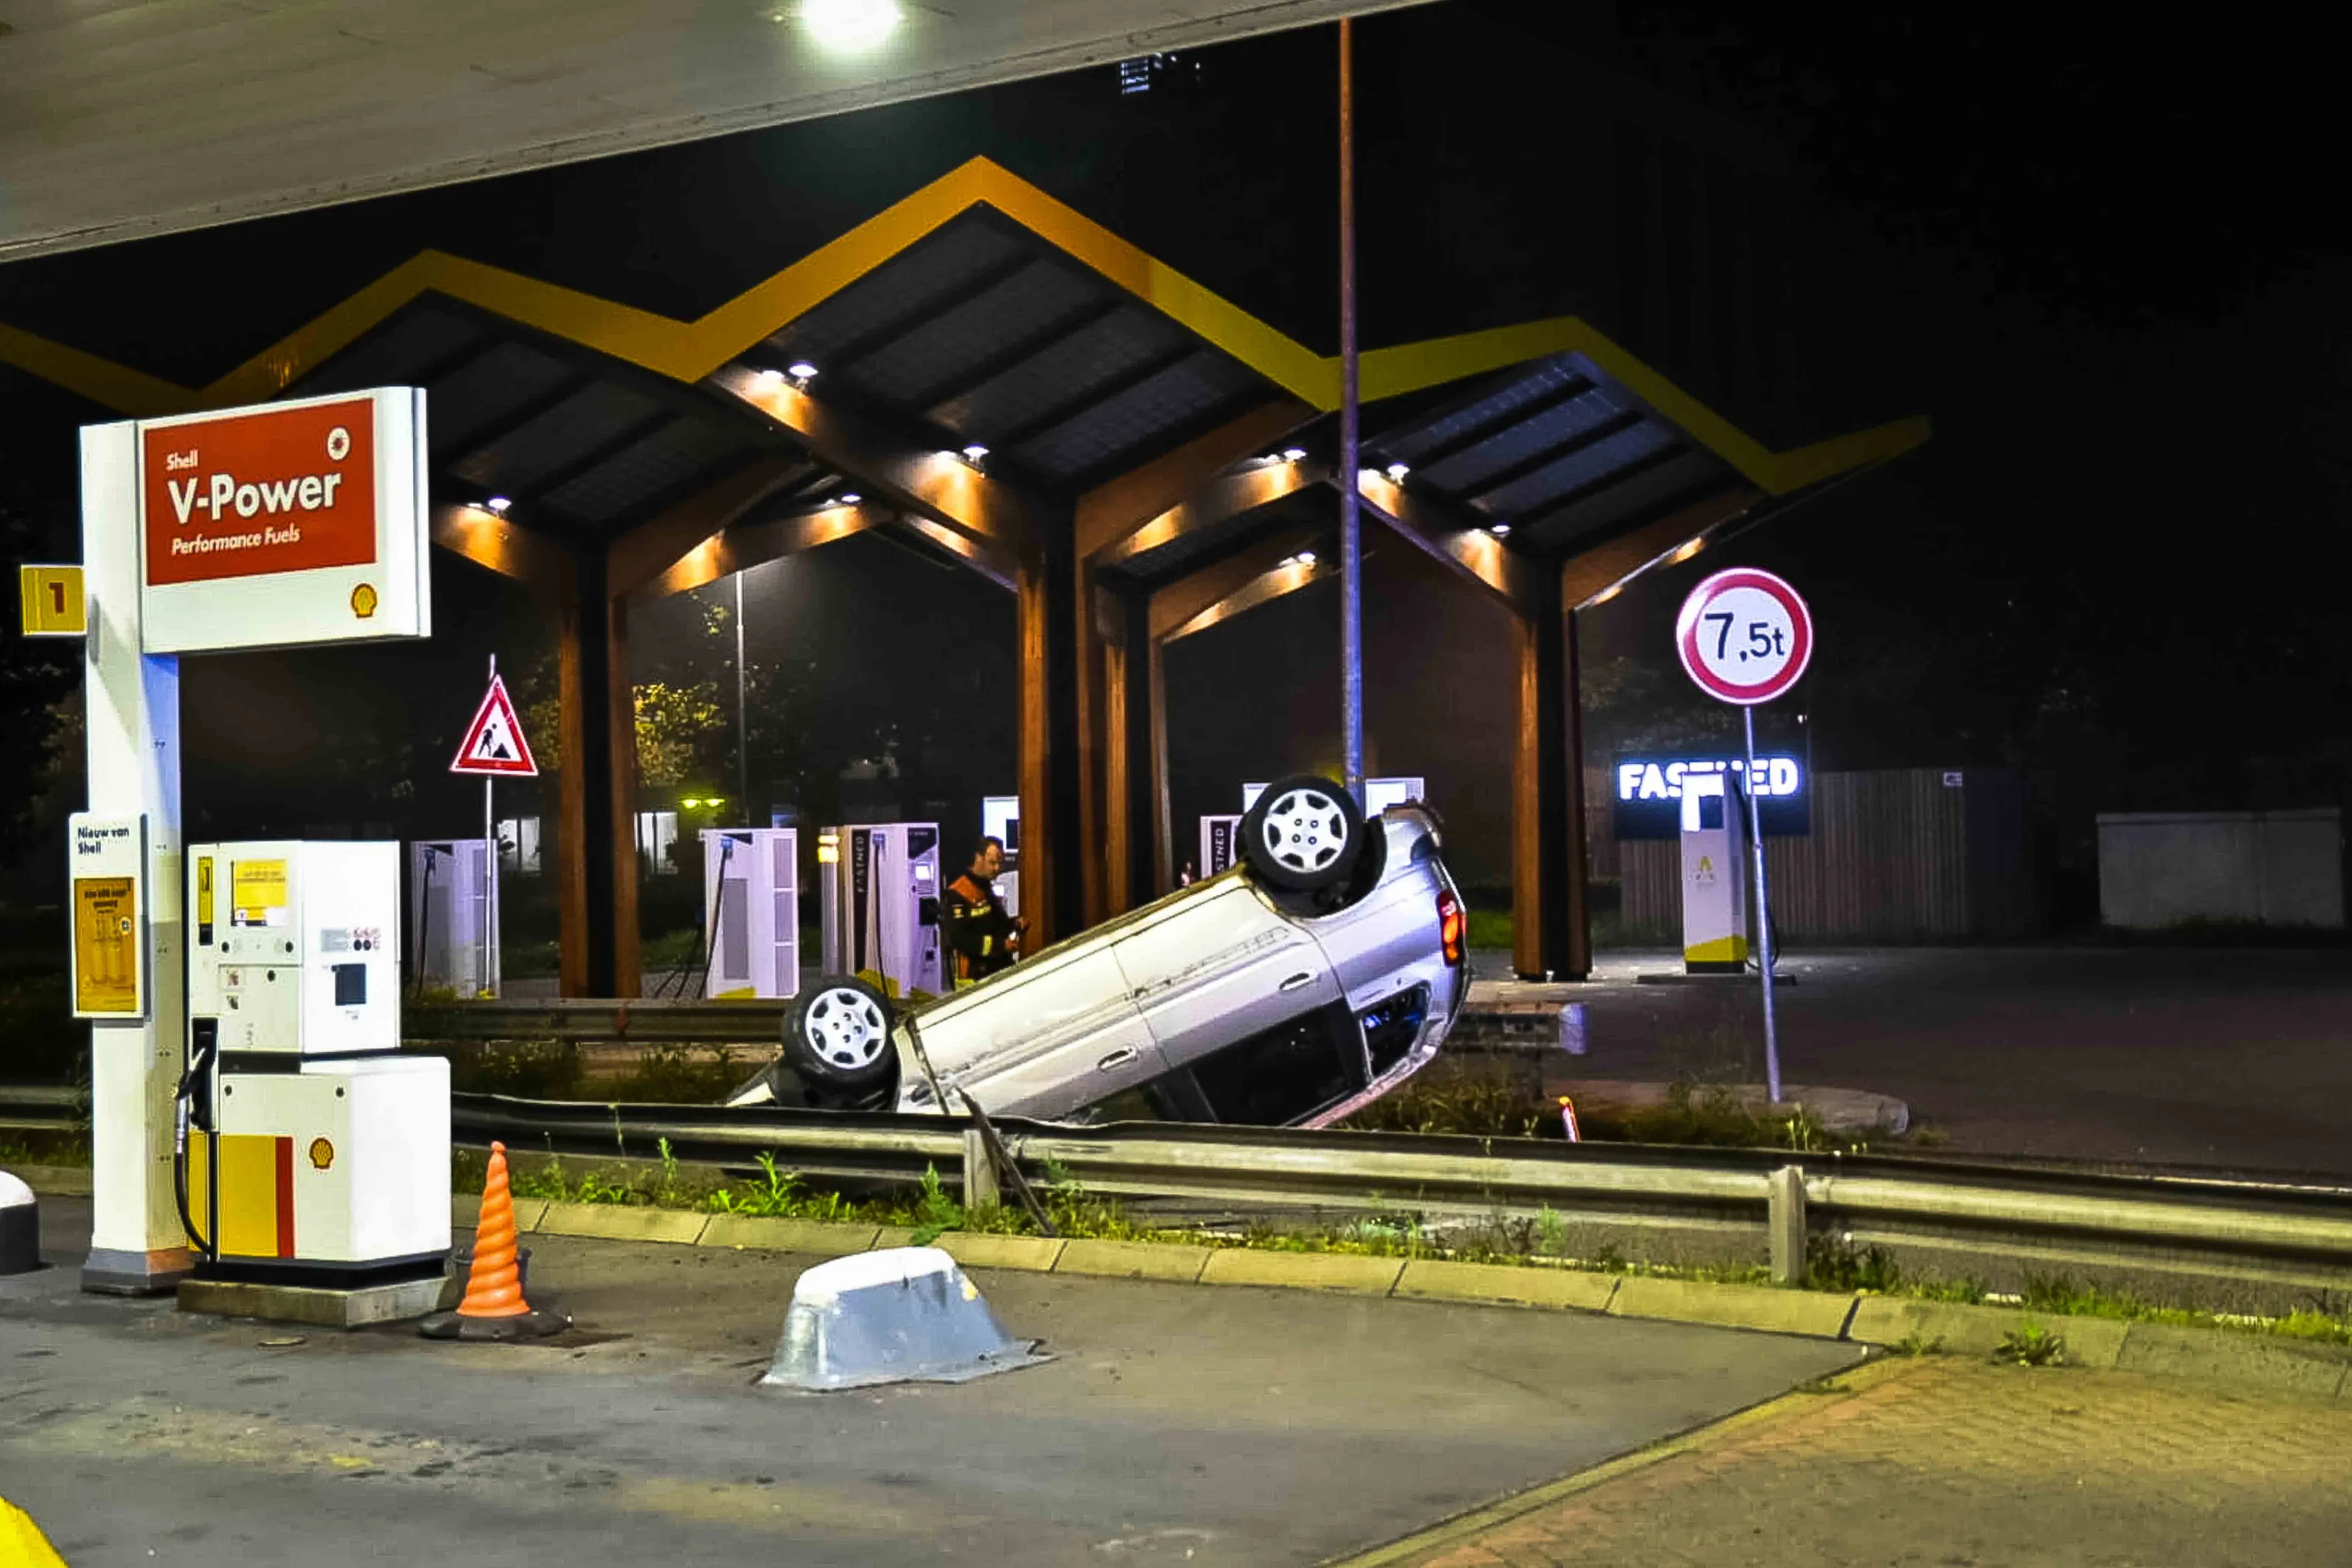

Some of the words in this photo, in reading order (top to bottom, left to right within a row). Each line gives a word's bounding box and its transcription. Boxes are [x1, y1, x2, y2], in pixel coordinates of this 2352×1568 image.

[165, 450, 198, 470] Shell
[167, 473, 341, 524] V-Power
[171, 532, 262, 556] Performance
[264, 522, 301, 545] Fuels
[48, 582, 64, 614] 1
[1619, 758, 1798, 799] FASED
[78, 840, 102, 855] Shell
[1215, 827, 1225, 872] STNED
